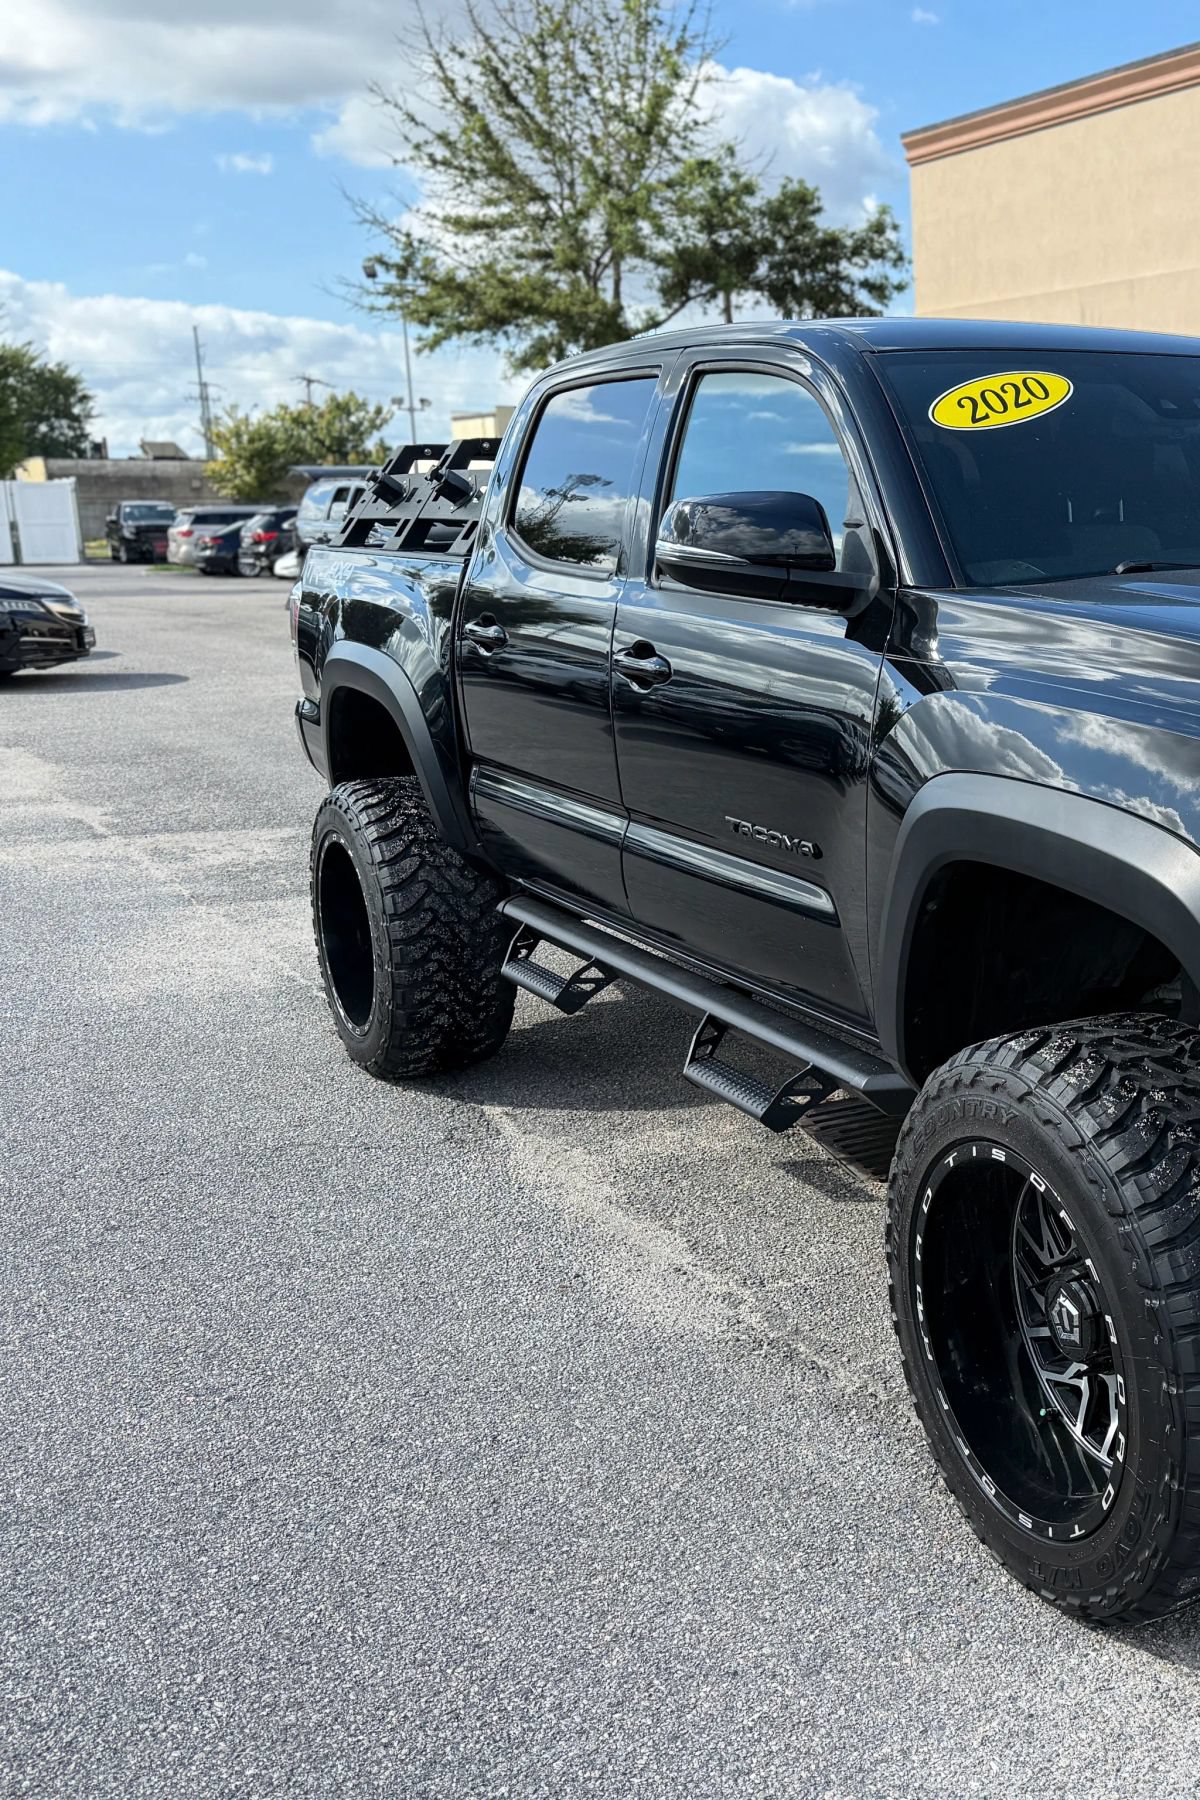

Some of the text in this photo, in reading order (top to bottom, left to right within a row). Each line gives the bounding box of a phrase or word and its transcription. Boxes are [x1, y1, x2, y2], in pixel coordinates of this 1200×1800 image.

[956, 376, 1050, 424] 2020
[724, 815, 820, 859] TACOMA
[912, 1098, 1019, 1156] COUNTRY
